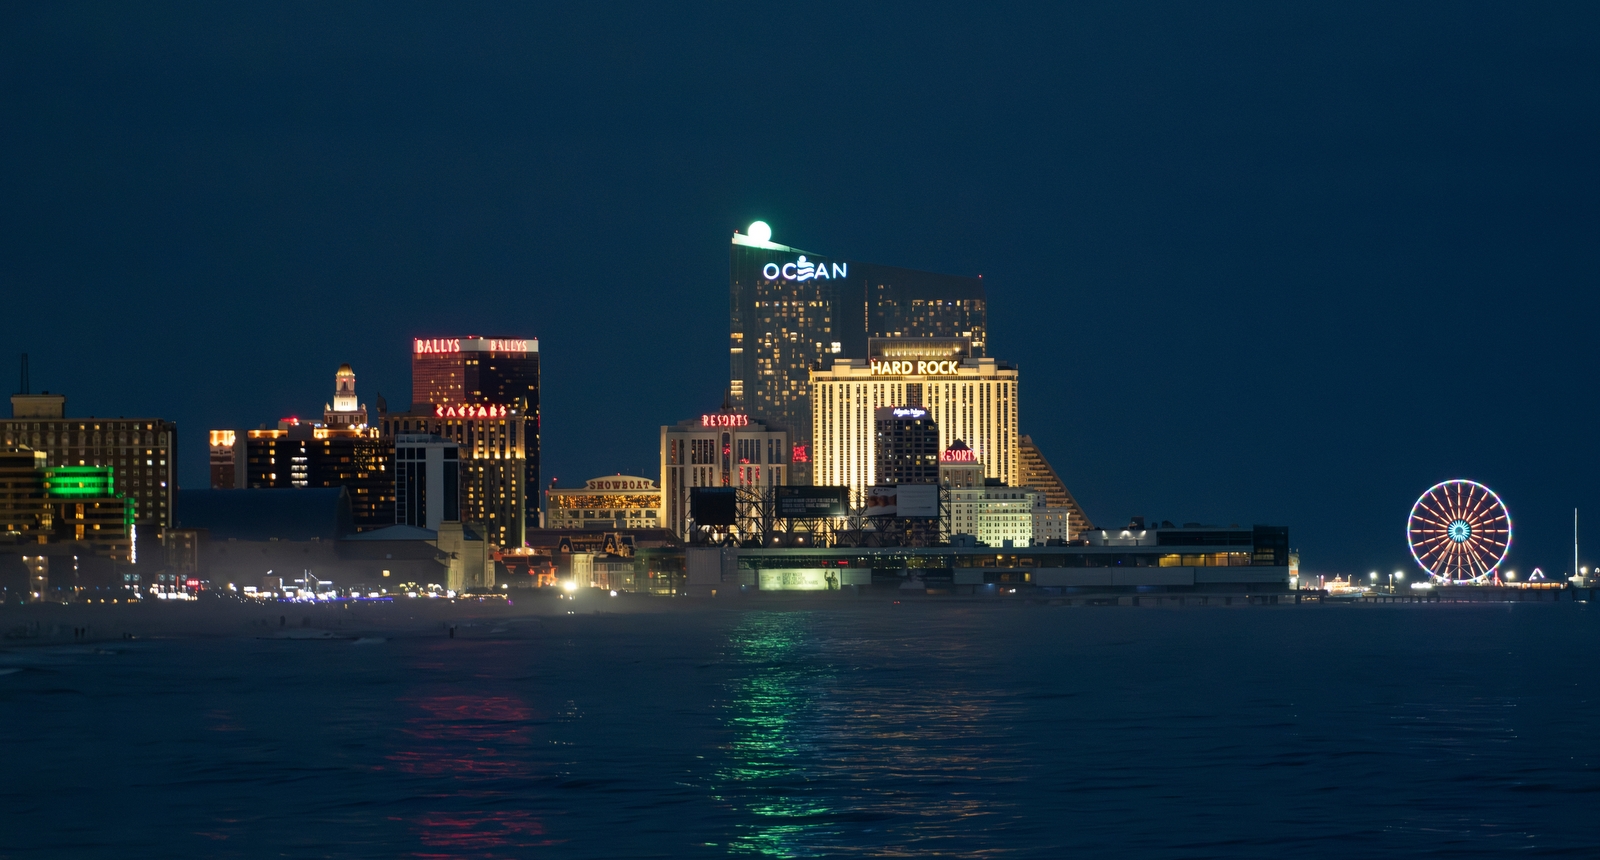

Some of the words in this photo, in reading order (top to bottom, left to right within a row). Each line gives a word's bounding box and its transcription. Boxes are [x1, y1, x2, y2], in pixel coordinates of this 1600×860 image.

[763, 255, 847, 281] OCEAN
[416, 339, 460, 353] BALLYS
[490, 340, 527, 352] BALLYS
[870, 361, 913, 375] HARD
[917, 361, 958, 375] ROCK
[436, 405, 507, 417] CAESARS
[702, 414, 748, 427] RESORTS
[940, 449, 977, 462] RESORTS
[589, 480, 650, 490] SHOWBOAT
